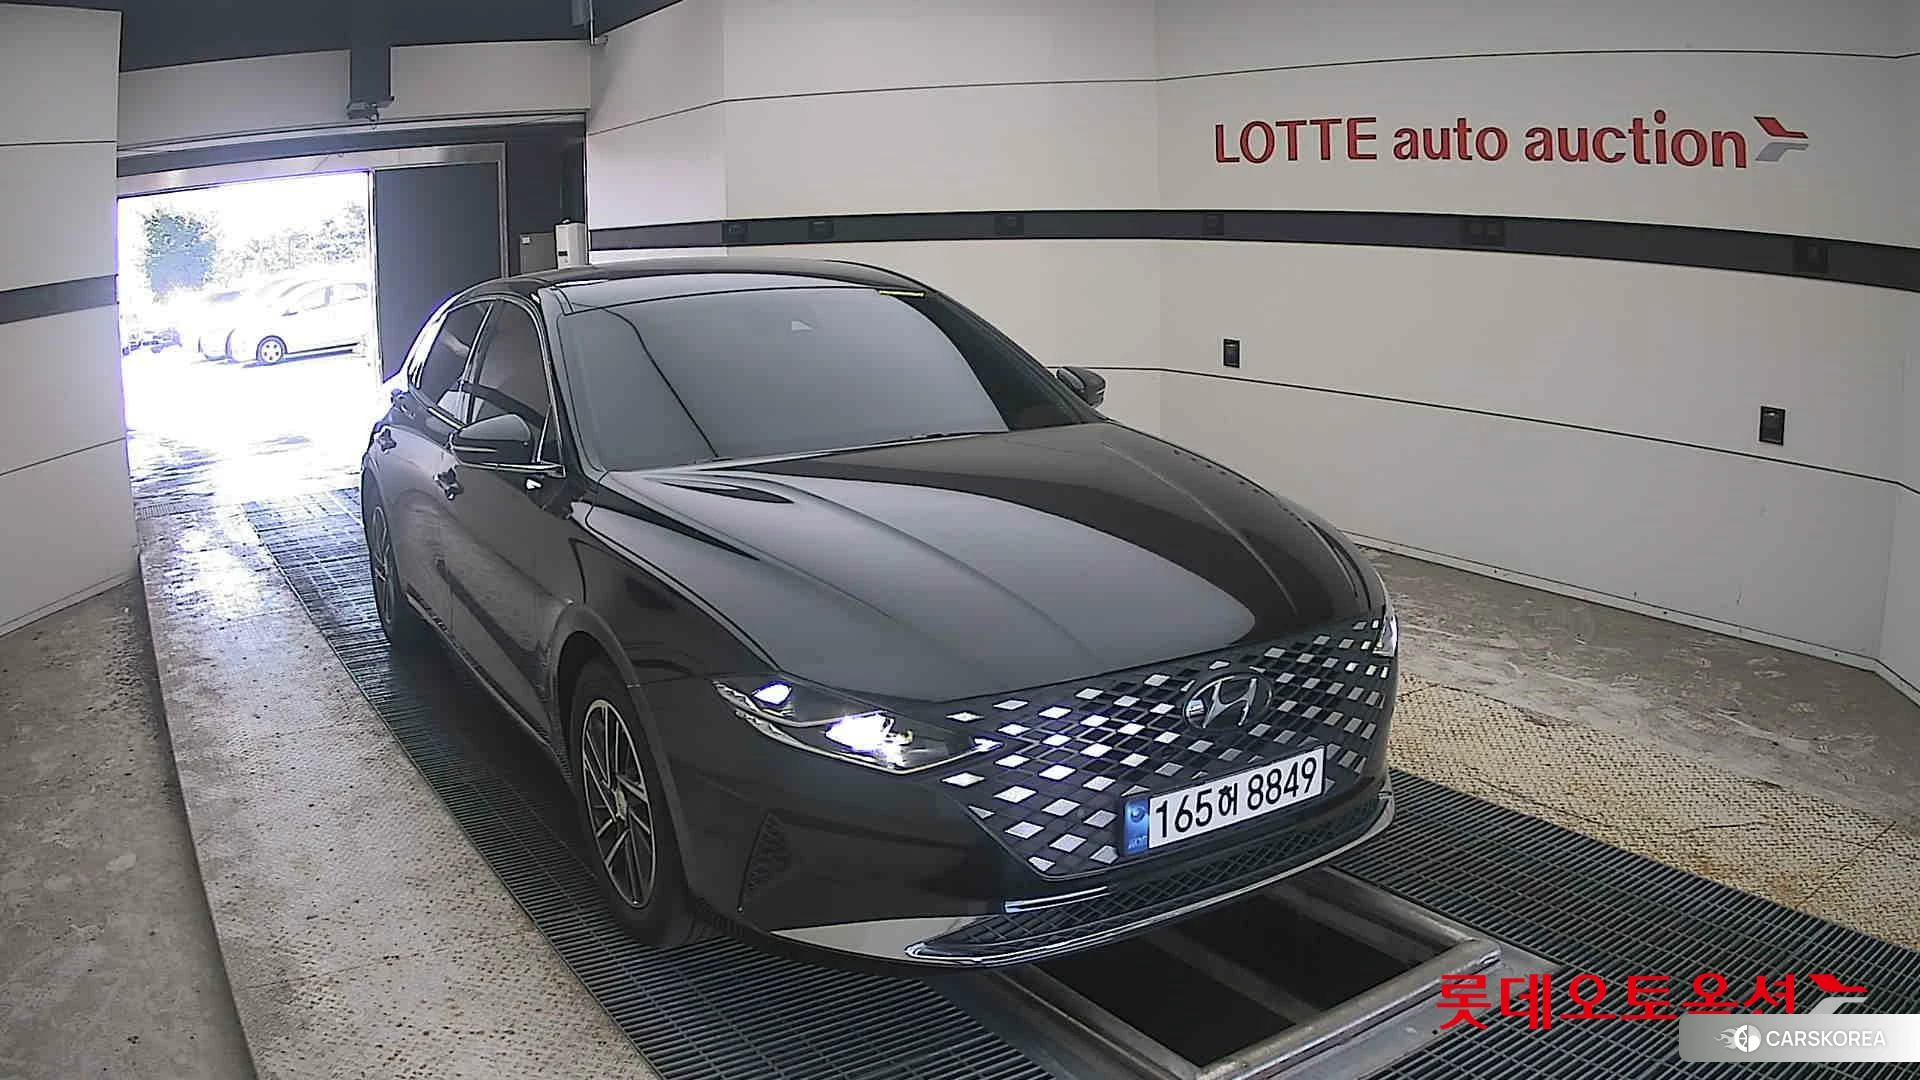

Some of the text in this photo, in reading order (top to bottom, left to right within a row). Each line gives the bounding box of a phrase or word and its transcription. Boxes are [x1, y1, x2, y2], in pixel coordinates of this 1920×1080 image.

[1214, 109, 1748, 169] LOTTE auto auction
[1155, 756, 1318, 838] 165허 8849
